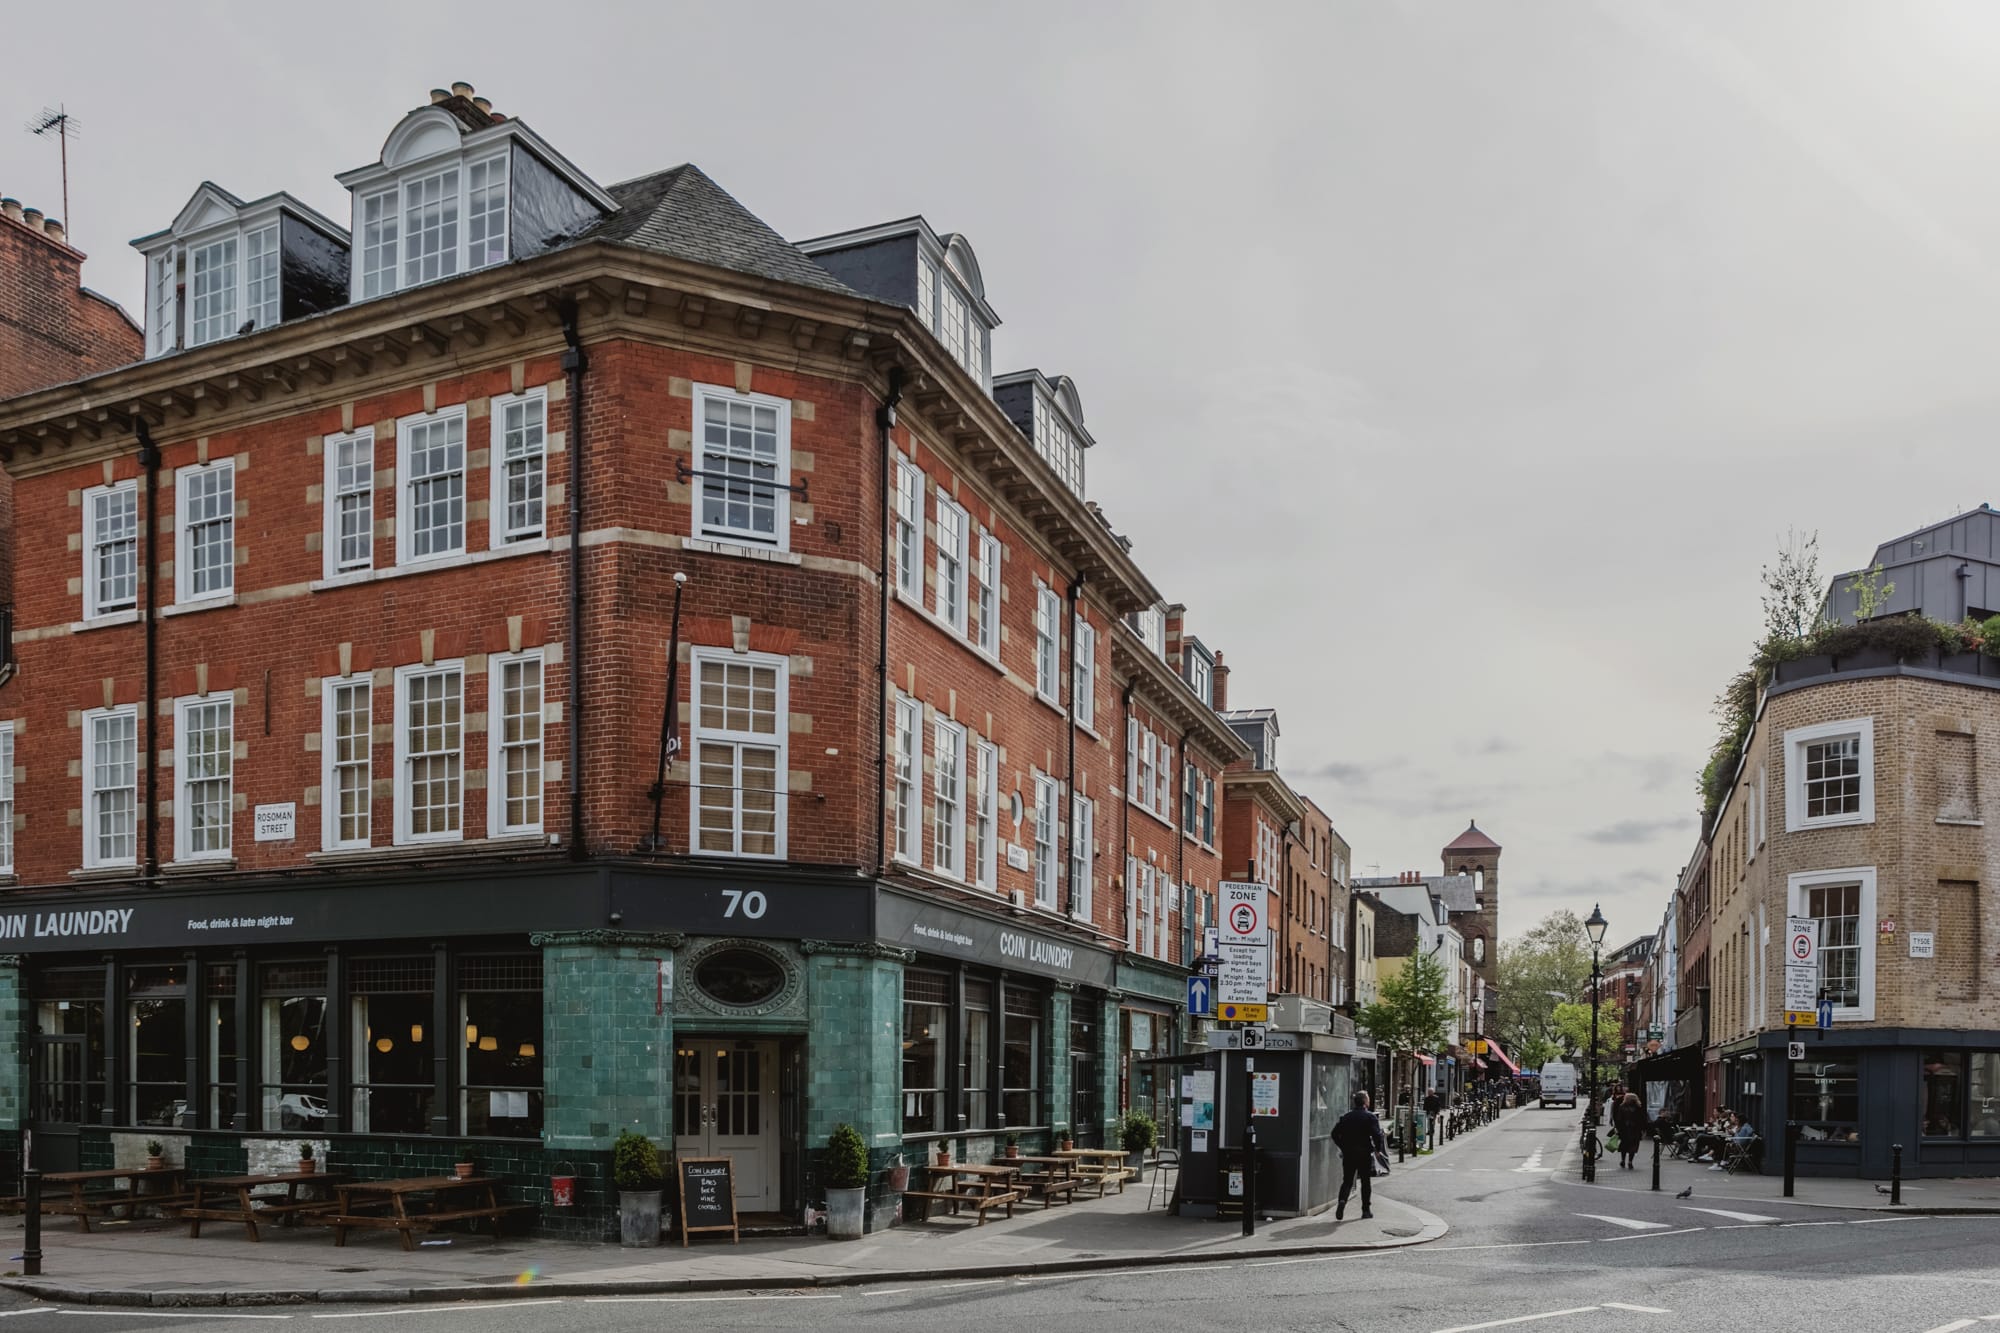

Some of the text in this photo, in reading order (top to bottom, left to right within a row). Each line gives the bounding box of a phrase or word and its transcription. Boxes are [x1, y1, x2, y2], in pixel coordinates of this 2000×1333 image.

[257, 811, 292, 822] ROSOMAN
[262, 824, 288, 834] STREET
[1230, 891, 1256, 900] ZONE
[722, 890, 767, 919] 70
[34, 908, 134, 937] LAUNDRY
[188, 916, 294, 930] Food, drink & late night bar
[1000, 932, 1074, 969] COIN LAUNDRY
